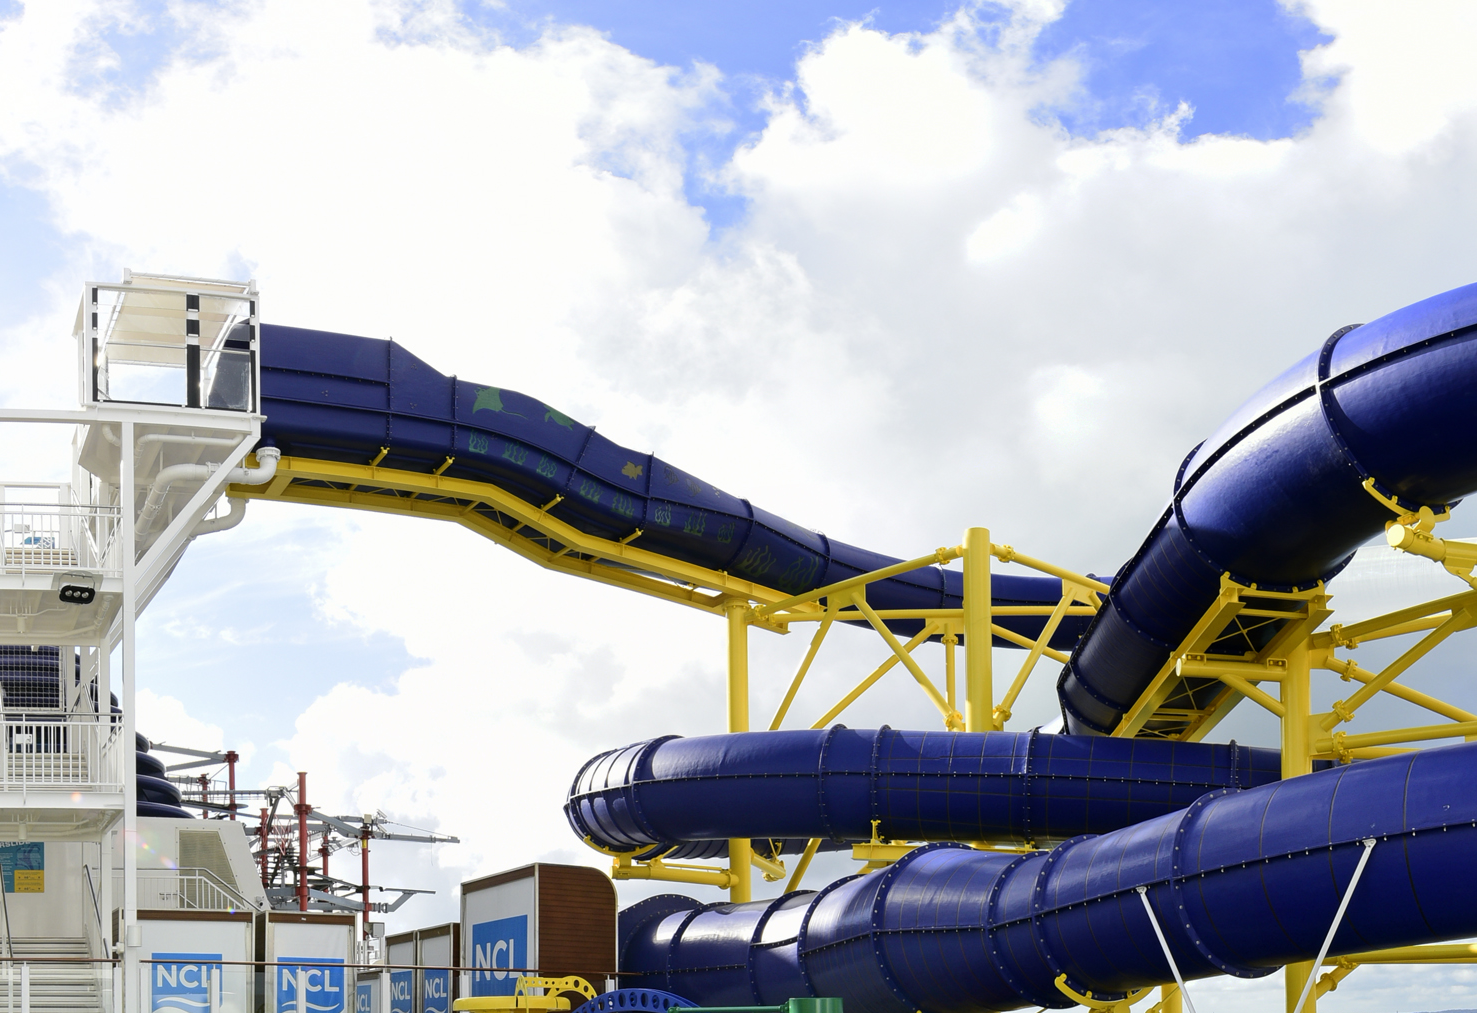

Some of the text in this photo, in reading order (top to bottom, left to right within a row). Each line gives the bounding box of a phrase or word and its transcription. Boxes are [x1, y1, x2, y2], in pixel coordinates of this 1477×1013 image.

[475, 938, 521, 981] NCL
[157, 965, 212, 988] NCL
[282, 968, 339, 992] NCL
[391, 981, 410, 1000] NCL
[425, 978, 447, 999] NCL
